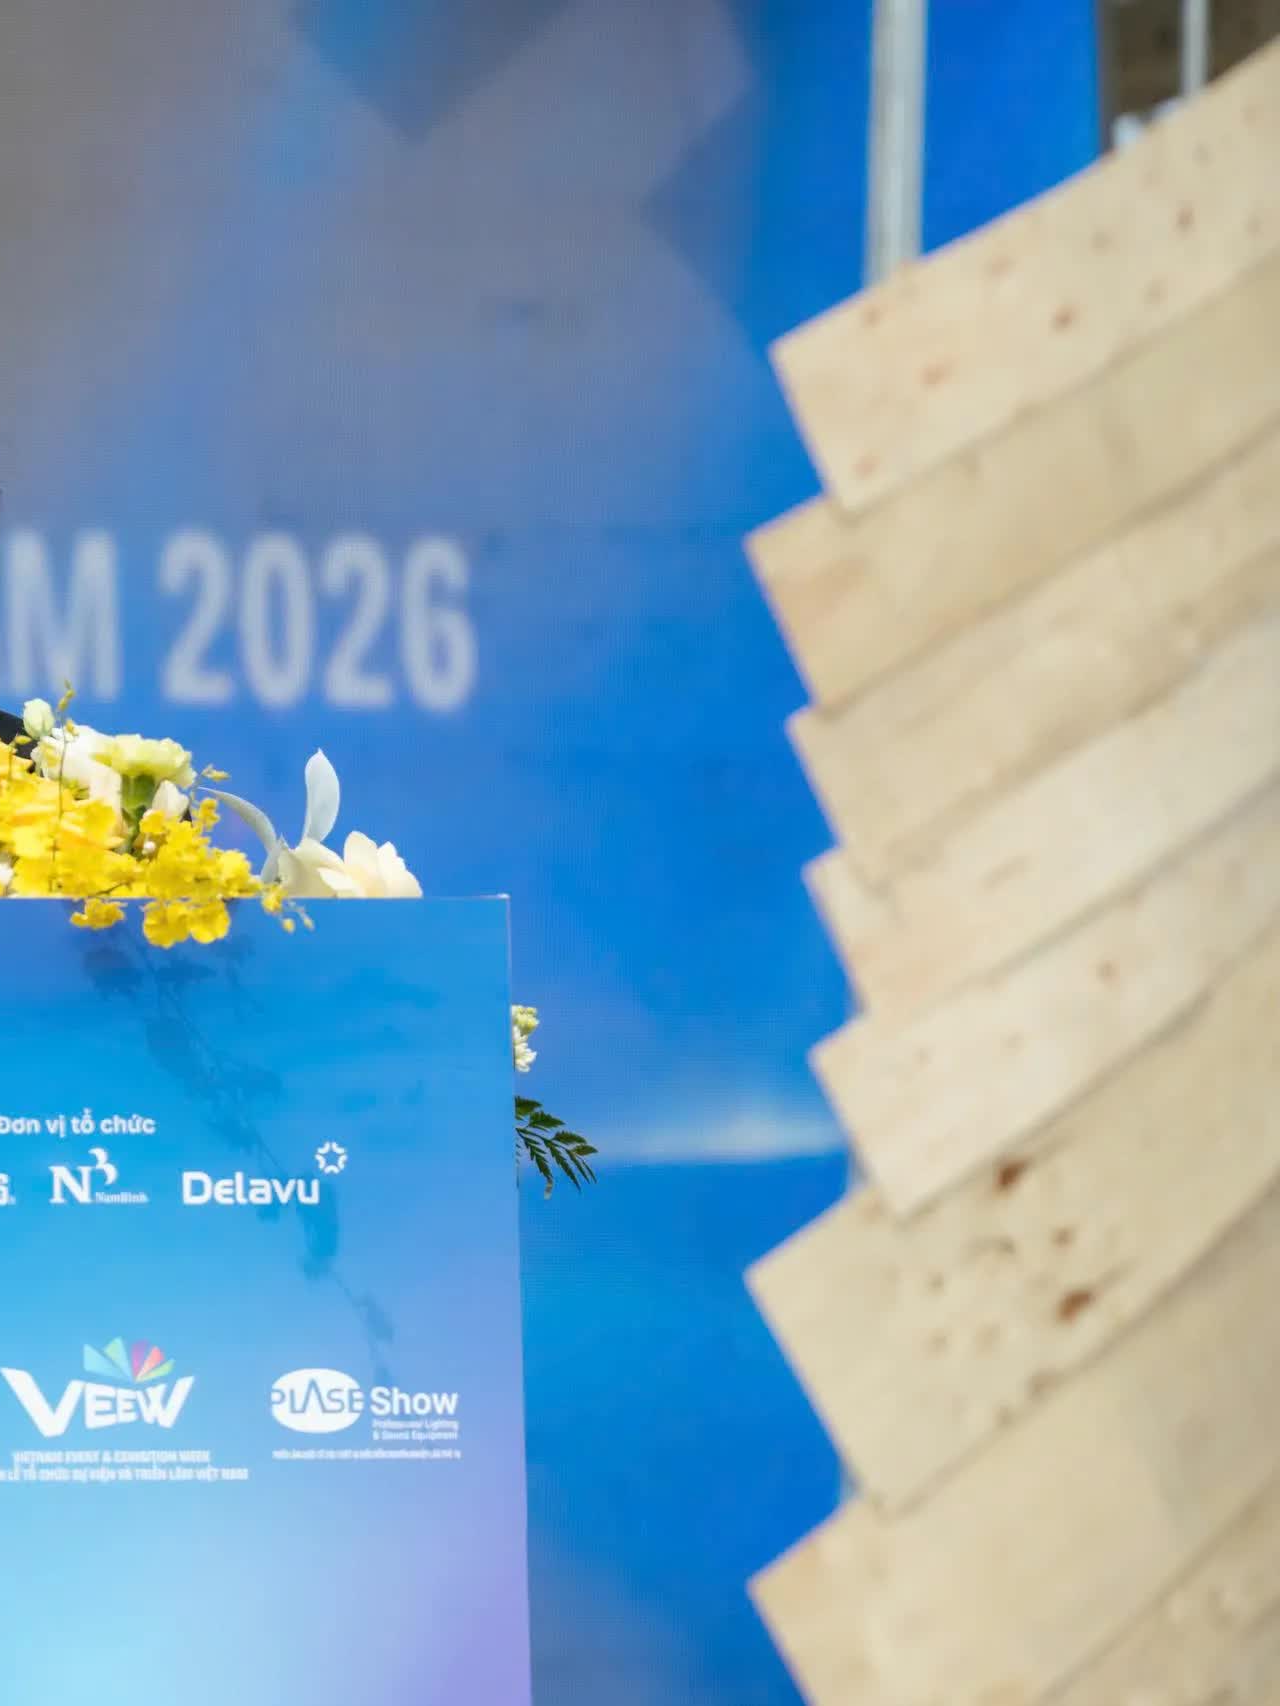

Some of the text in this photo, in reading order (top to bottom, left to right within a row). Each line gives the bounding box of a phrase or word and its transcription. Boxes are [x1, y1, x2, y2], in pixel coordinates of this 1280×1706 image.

[155, 528, 477, 712] 2026
[45, 1114, 66, 1138] vị
[71, 1107, 96, 1135] tổ
[100, 1113, 156, 1135] chức
[182, 1170, 320, 1206] Delavu
[370, 1386, 458, 1416] Show
